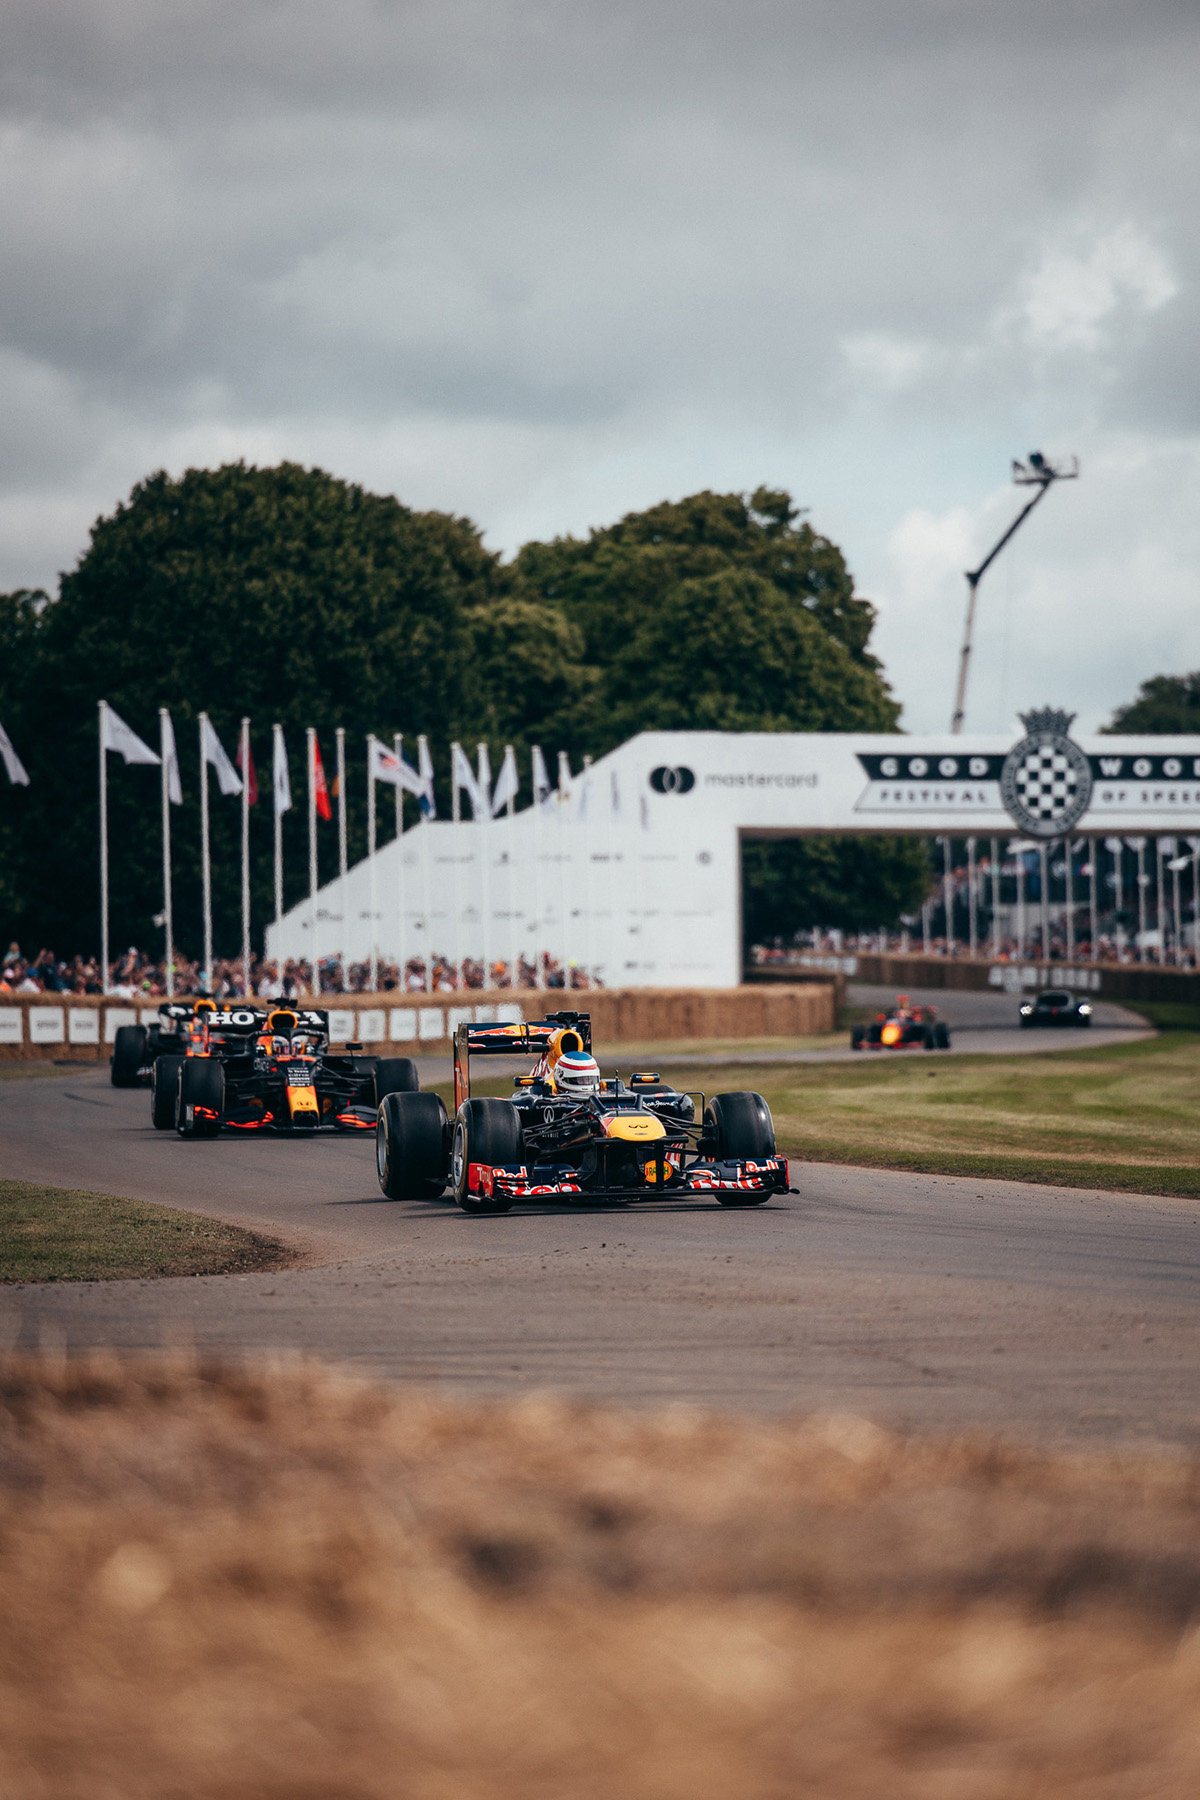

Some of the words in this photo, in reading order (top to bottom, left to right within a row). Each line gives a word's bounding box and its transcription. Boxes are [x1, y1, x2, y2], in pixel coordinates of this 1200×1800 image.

[880, 757, 989, 777] GOOD
[705, 774, 818, 788] mastercard
[880, 790, 987, 802] FESTIVAL
[1102, 790, 1126, 802] OF
[207, 1011, 325, 1025] HOA
